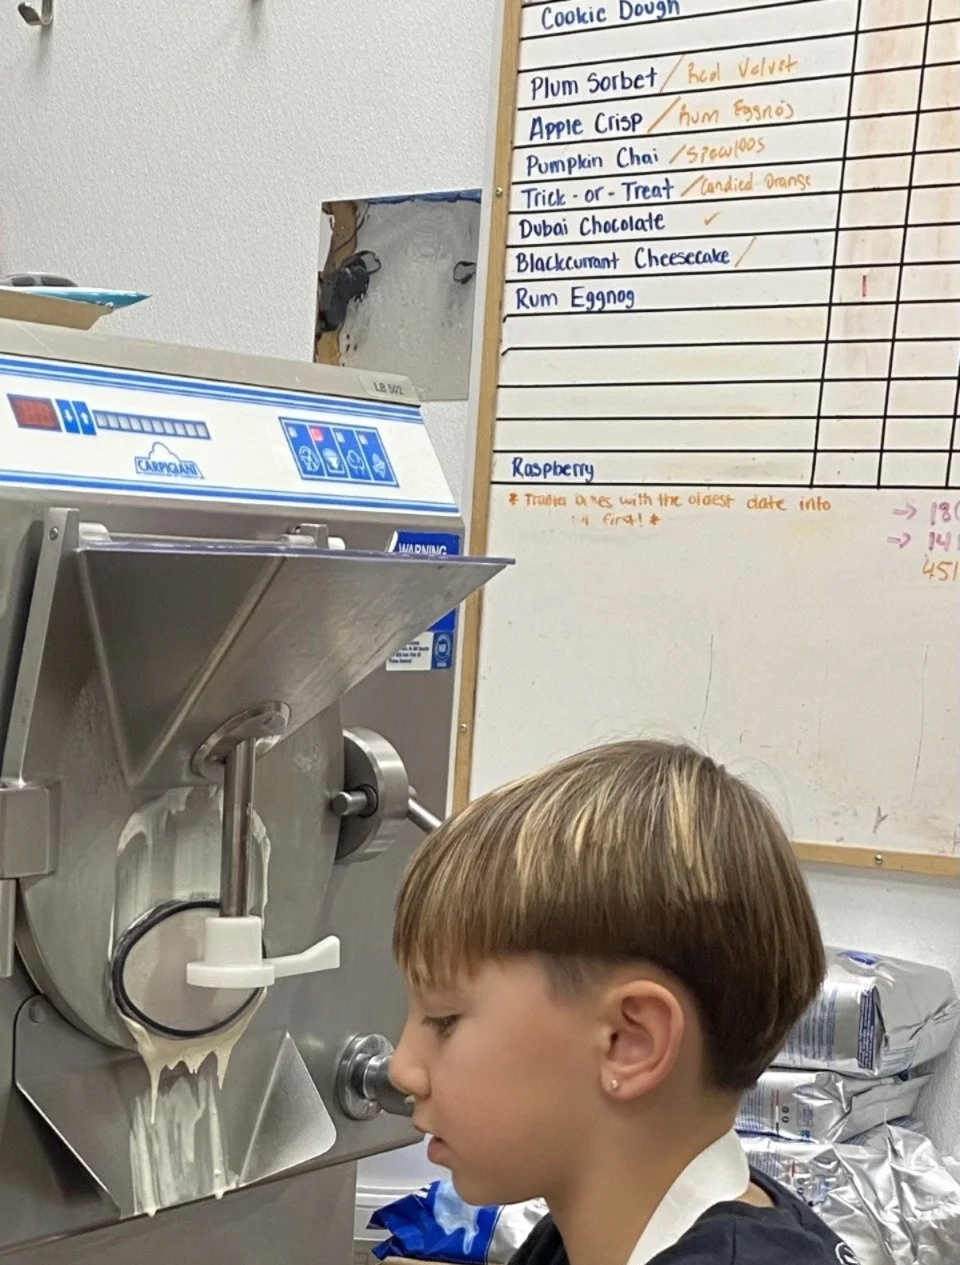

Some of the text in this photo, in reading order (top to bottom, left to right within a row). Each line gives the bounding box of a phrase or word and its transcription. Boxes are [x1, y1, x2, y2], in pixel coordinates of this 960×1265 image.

[541, 0, 680, 30] Cookie Dough
[531, 76, 578, 100] Plum
[588, 66, 657, 94] Sorbet
[529, 115, 584, 141] Apple
[595, 112, 643, 134] Crisp
[527, 153, 603, 177] Pumpkin
[617, 147, 659, 168] Chai
[519, 211, 665, 239] Dubai Chocolate
[516, 247, 730, 273] Blackcurrant Cheesecake
[516, 286, 635, 312] Rum Eggnog
[137, 459, 198, 476] CARPIGIANI
[512, 457, 594, 484] Raspberry
[620, 492, 652, 507] with
[746, 494, 787, 511] date
